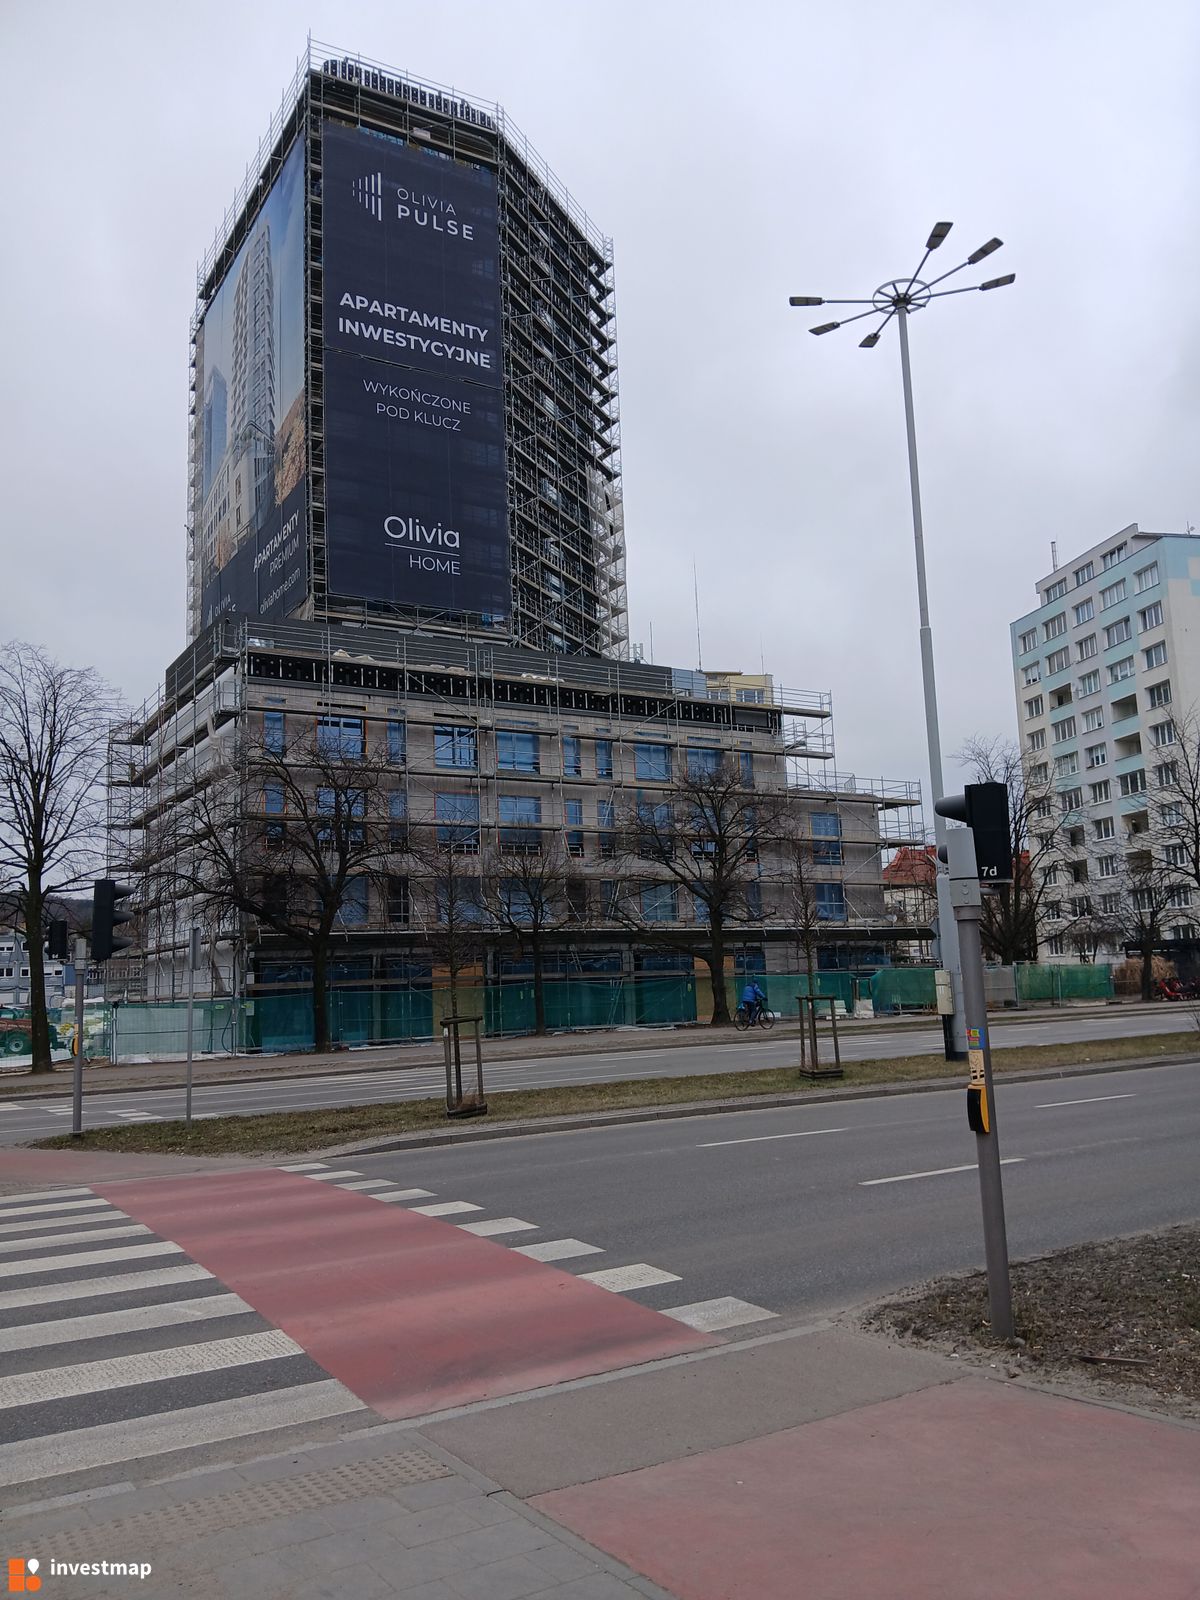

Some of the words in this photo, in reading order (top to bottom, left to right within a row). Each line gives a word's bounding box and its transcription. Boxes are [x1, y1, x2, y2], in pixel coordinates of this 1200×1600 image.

[397, 188, 457, 216] OLIVIA
[397, 204, 474, 241] PULSE
[339, 292, 489, 342] APARTAMENTY
[338, 317, 491, 369] INWESTYCYJNE
[362, 379, 472, 415] WYKOŃCZONE
[376, 402, 410, 420] POD
[414, 410, 462, 432] KLUCZ
[253, 509, 300, 574] APARTAMENTY
[383, 515, 460, 549] Olivia
[269, 533, 300, 577] PREMIUM
[409, 554, 461, 576] HOME
[981, 865, 998, 877] 7d
